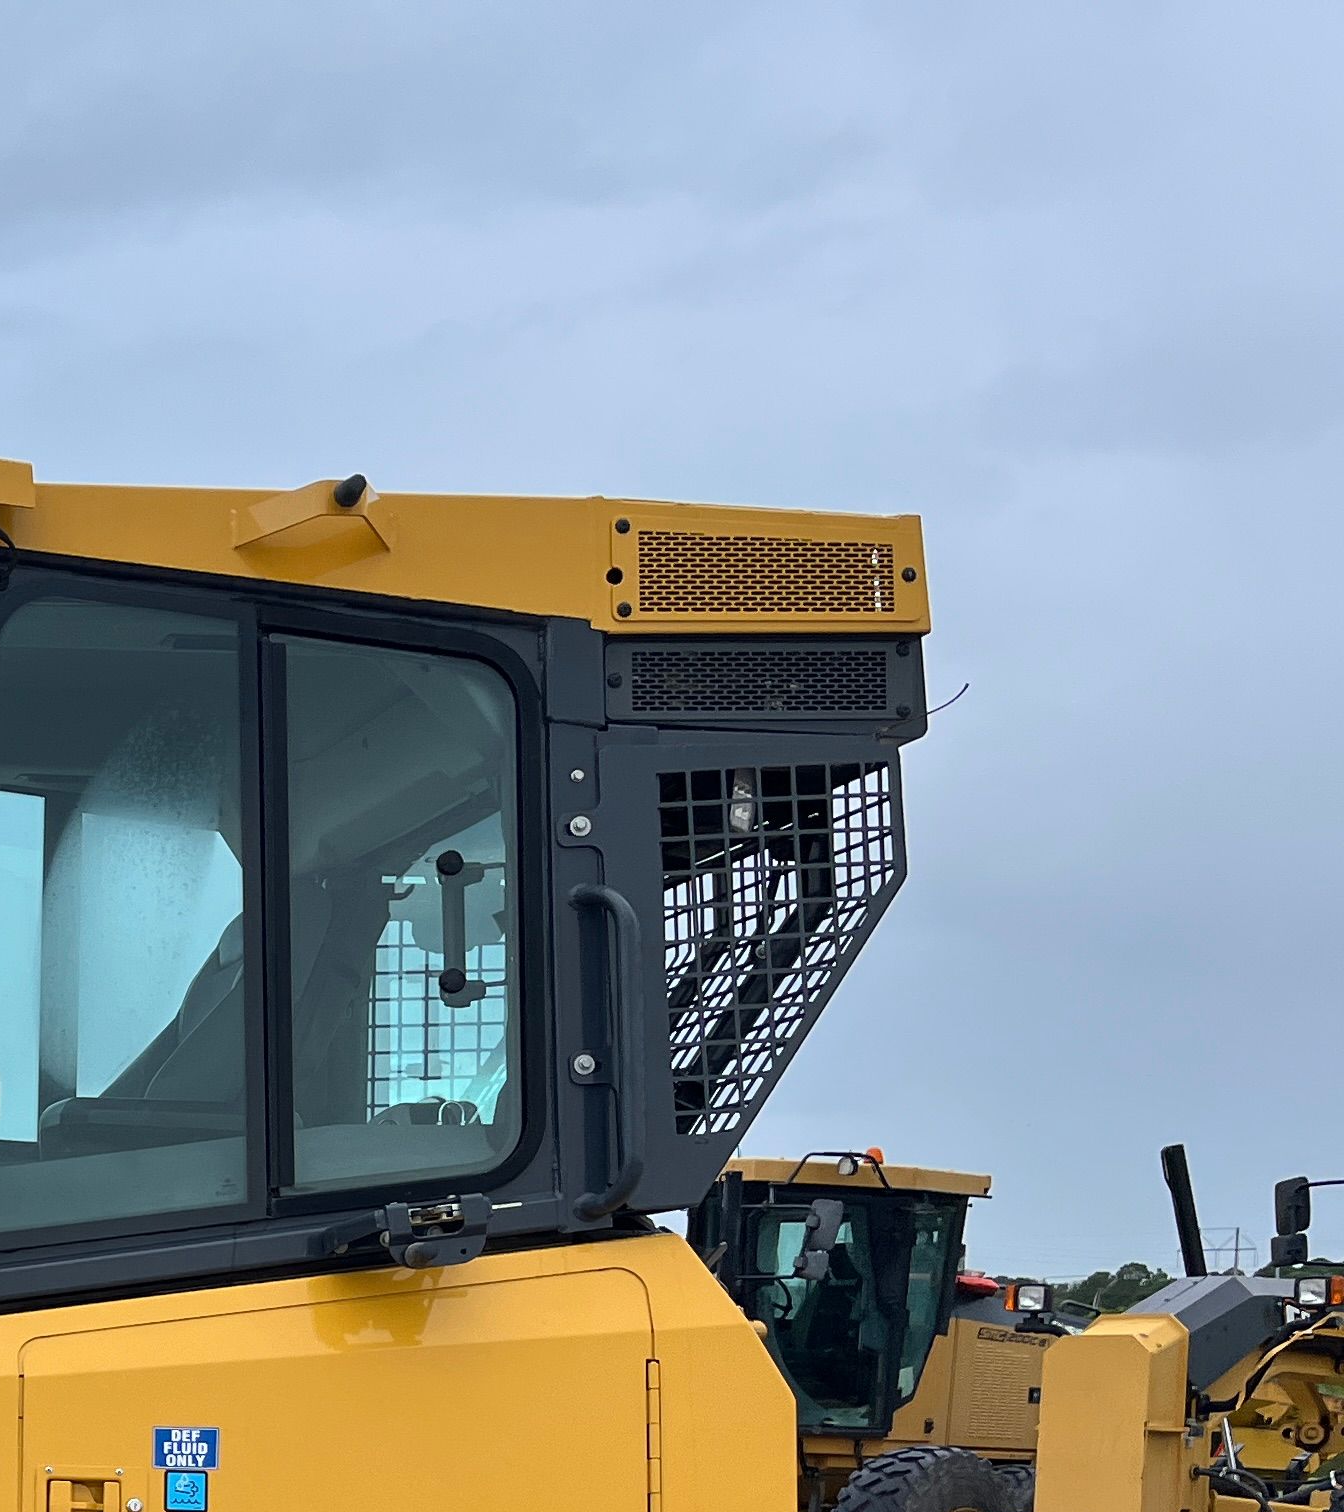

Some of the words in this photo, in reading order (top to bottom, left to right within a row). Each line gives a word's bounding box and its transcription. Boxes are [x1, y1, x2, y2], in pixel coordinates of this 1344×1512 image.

[170, 1429, 201, 1442] DEF
[163, 1441, 209, 1455] FLUID
[165, 1454, 207, 1468] ONLY
